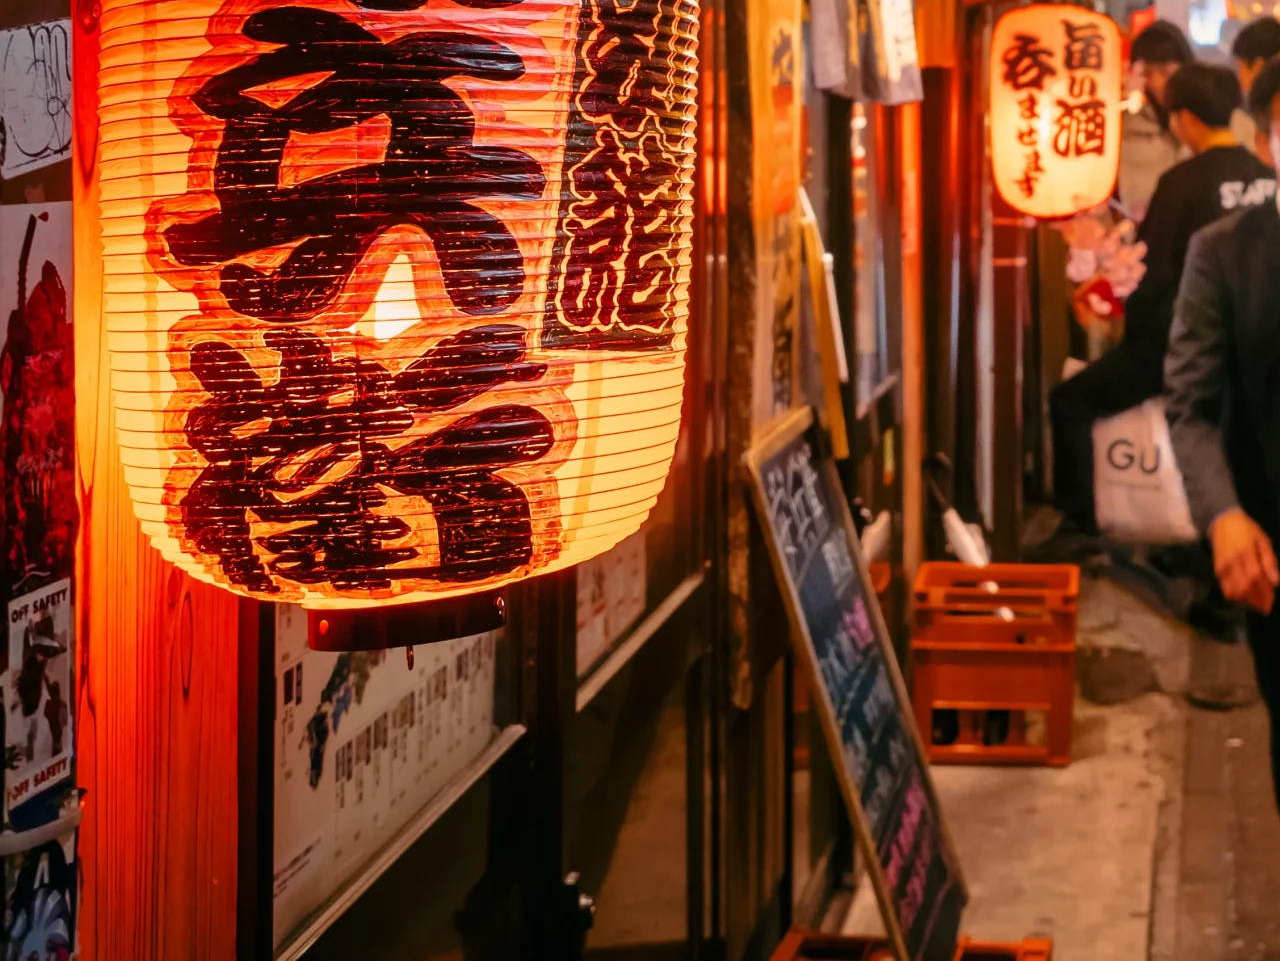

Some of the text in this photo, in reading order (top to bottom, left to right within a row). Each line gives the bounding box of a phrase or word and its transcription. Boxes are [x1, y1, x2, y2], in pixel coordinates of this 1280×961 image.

[1107, 439, 1162, 474] GU
[33, 586, 68, 614] SAFETY
[34, 756, 68, 789] SAFETY
